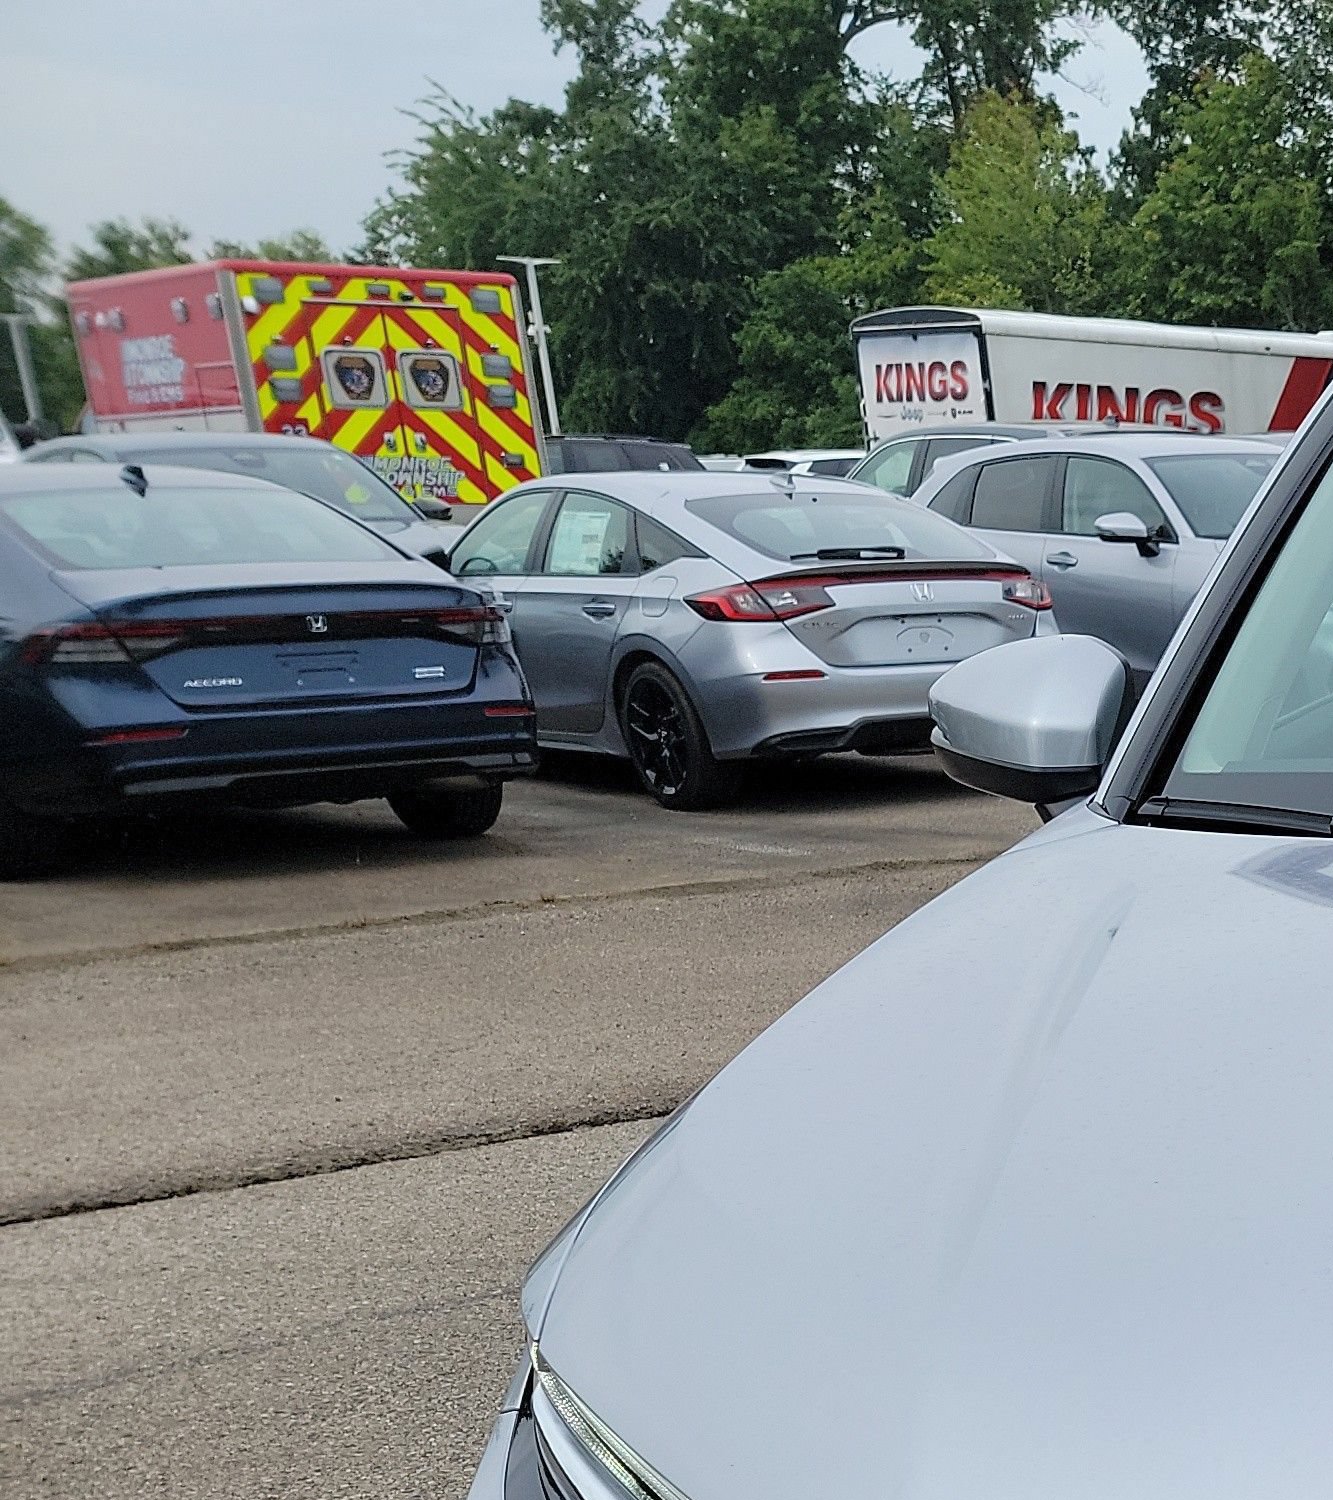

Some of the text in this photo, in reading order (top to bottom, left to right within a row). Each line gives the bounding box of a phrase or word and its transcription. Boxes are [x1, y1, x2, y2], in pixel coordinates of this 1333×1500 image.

[875, 360, 969, 403] KINGS
[1032, 381, 1224, 432] KINGS
[374, 455, 452, 472] MONROE
